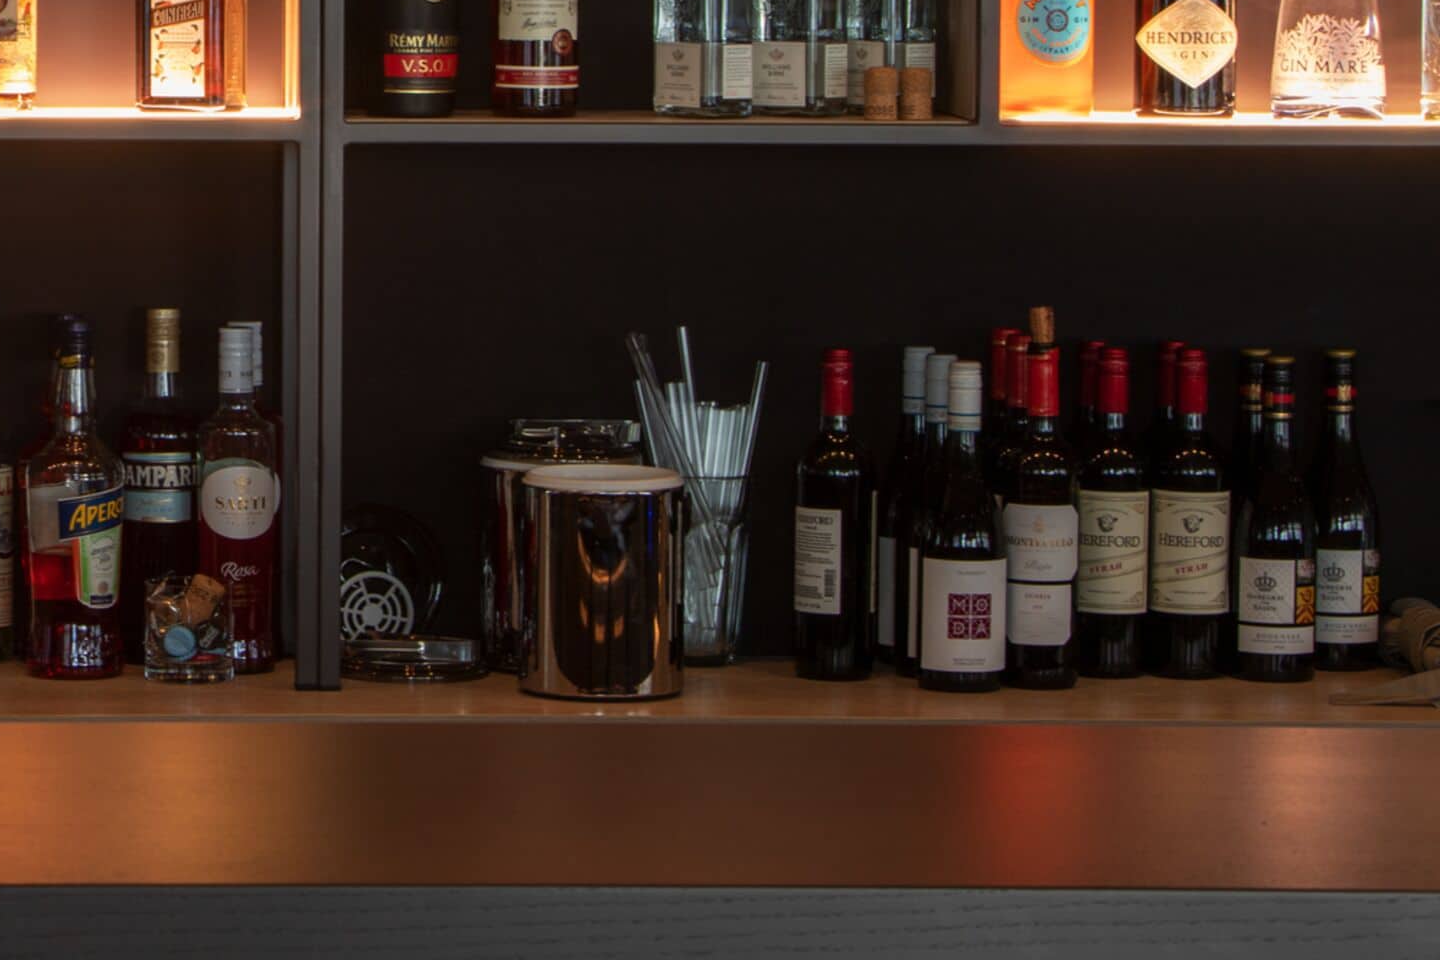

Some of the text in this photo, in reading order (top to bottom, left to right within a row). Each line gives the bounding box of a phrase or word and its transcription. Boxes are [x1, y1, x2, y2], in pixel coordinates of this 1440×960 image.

[1020, 16, 1040, 24] GIN
[388, 32, 426, 48] RÉMY
[1179, 50, 1210, 59] GIN
[1280, 58, 1369, 73] GIN MARE
[125, 463, 197, 488] AMPARI
[215, 496, 267, 511] SARTI
[68, 493, 125, 532] APERO
[1160, 533, 1225, 548] HEREFORD
[1088, 562, 1124, 575] SYRAH
[1175, 562, 1210, 576] SYRAH
